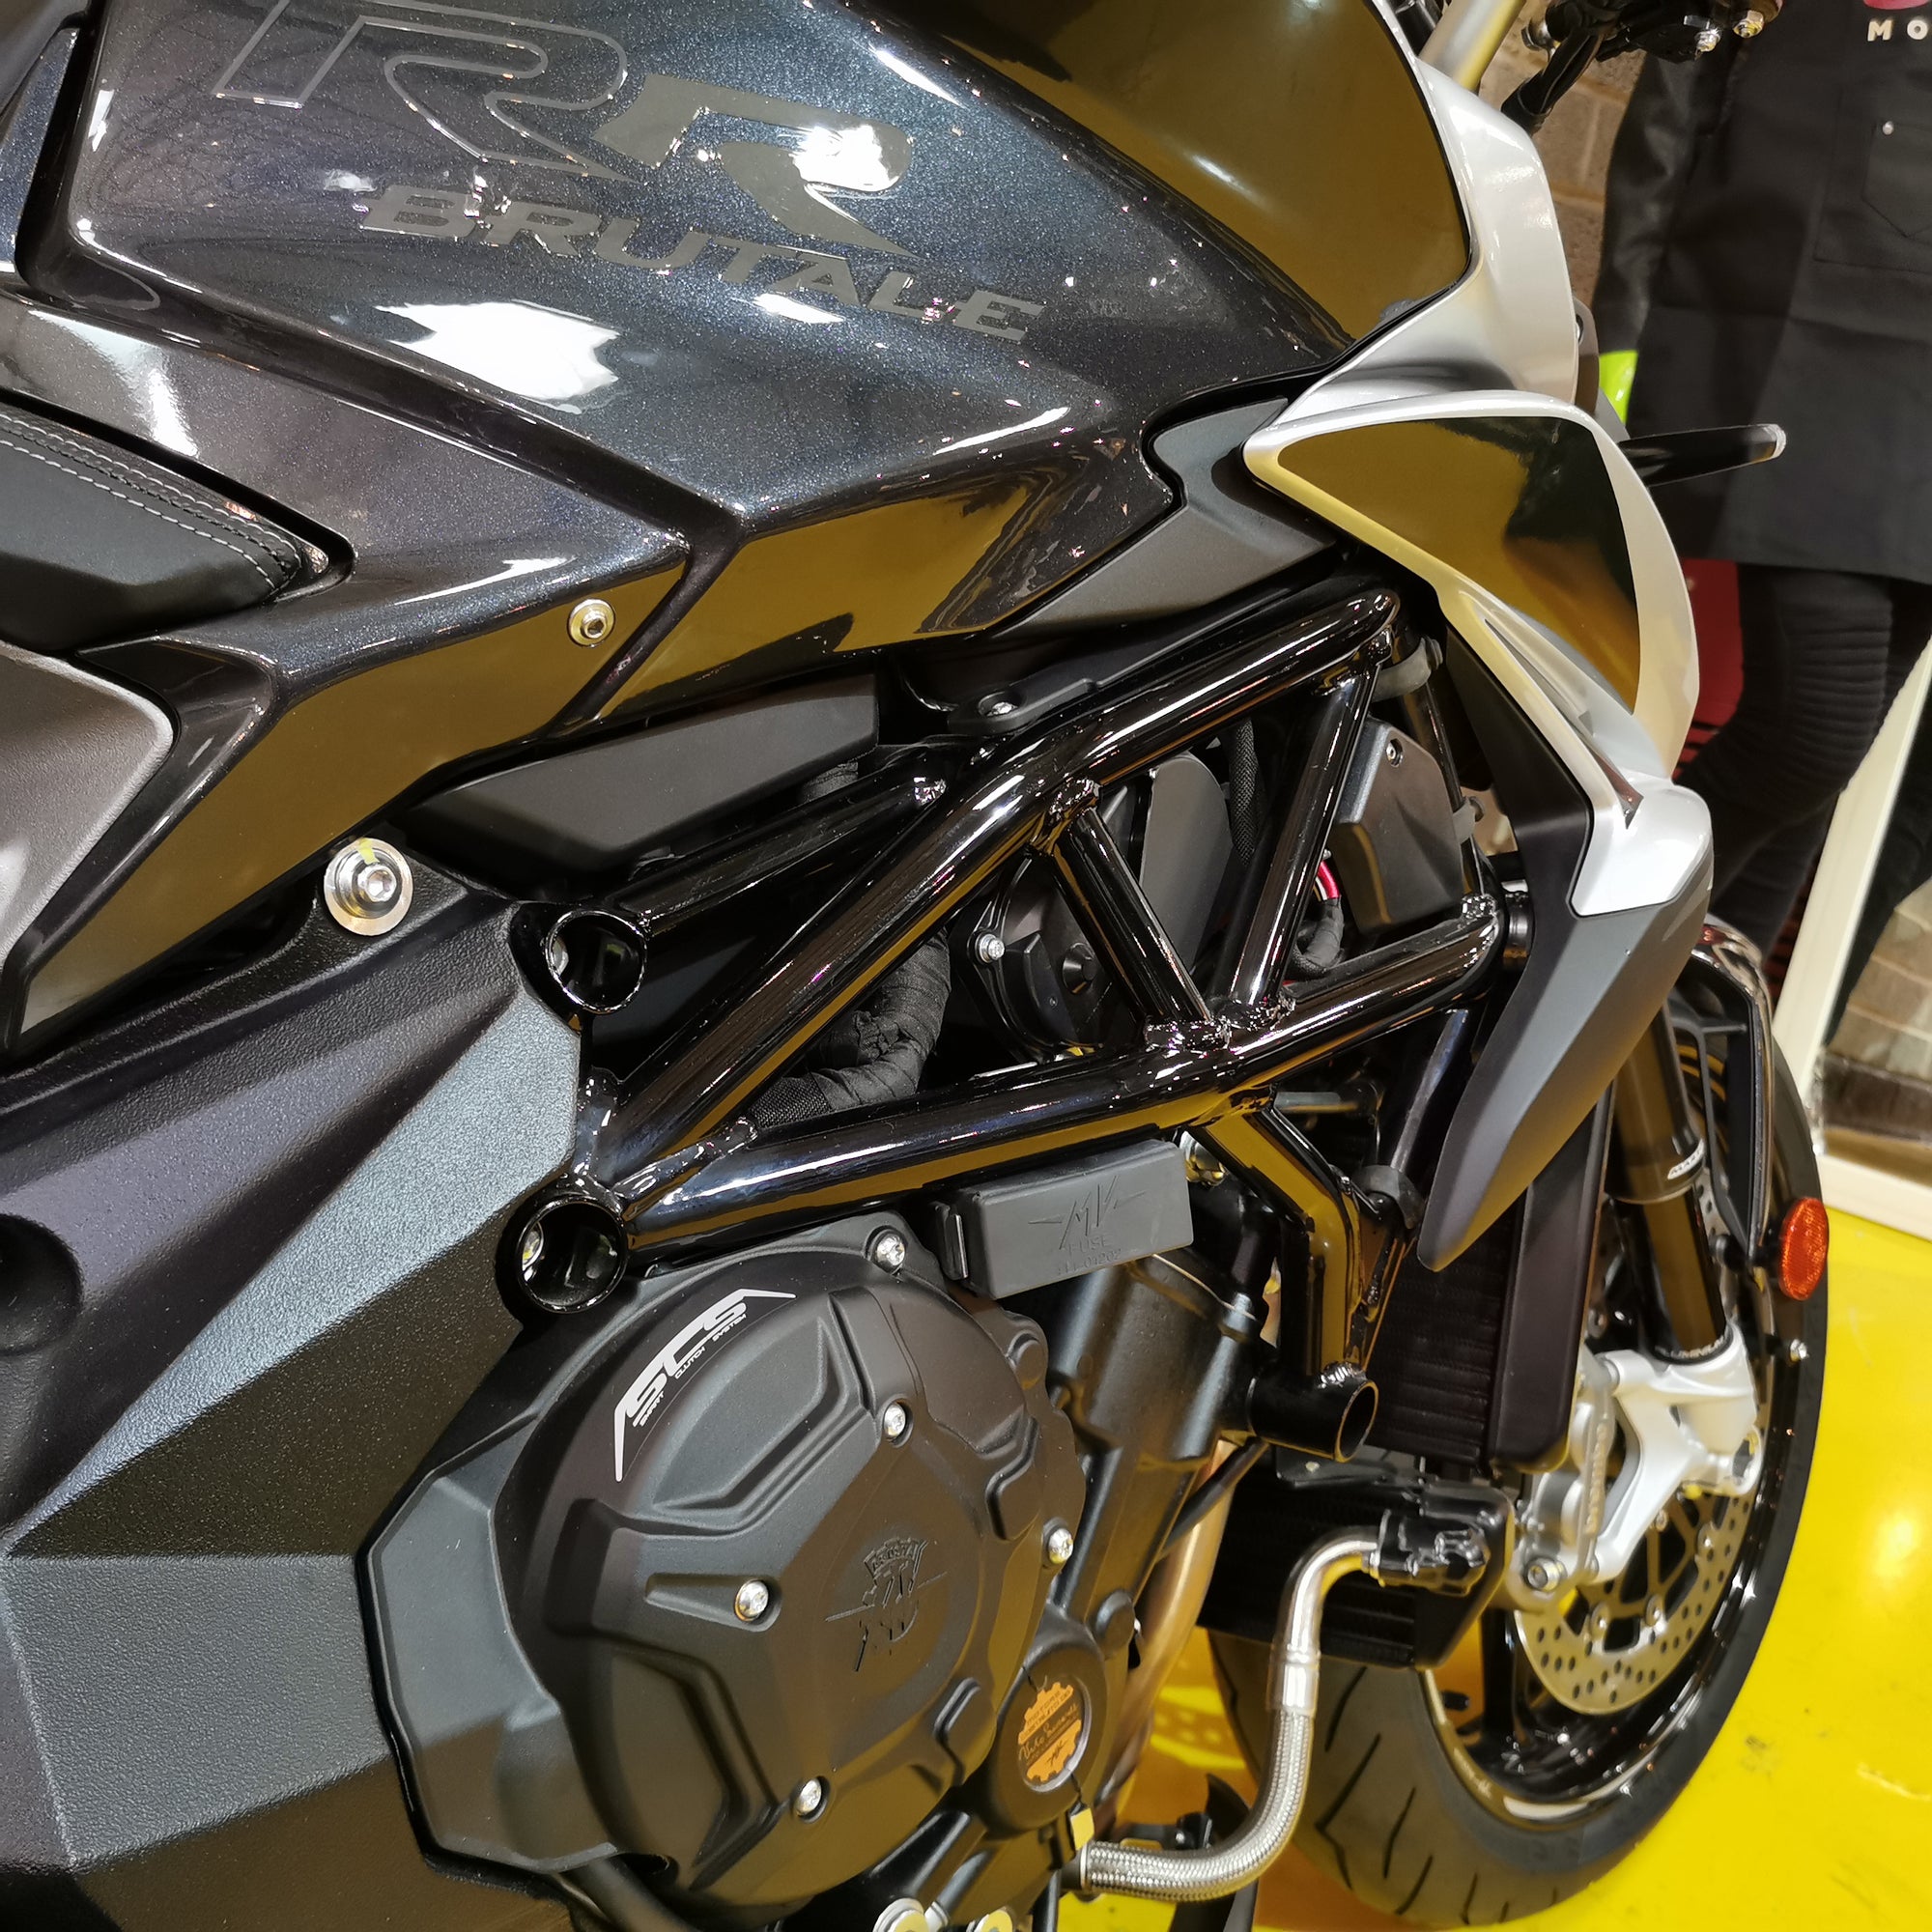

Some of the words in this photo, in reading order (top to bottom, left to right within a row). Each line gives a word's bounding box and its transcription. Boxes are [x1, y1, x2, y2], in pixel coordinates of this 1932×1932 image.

[358, 184, 1046, 343] BRUTALE
[1067, 1236, 1111, 1255] FUSE
[674, 1347, 706, 1379] CLUTCH
[711, 1314, 747, 1342] SYSTEM
